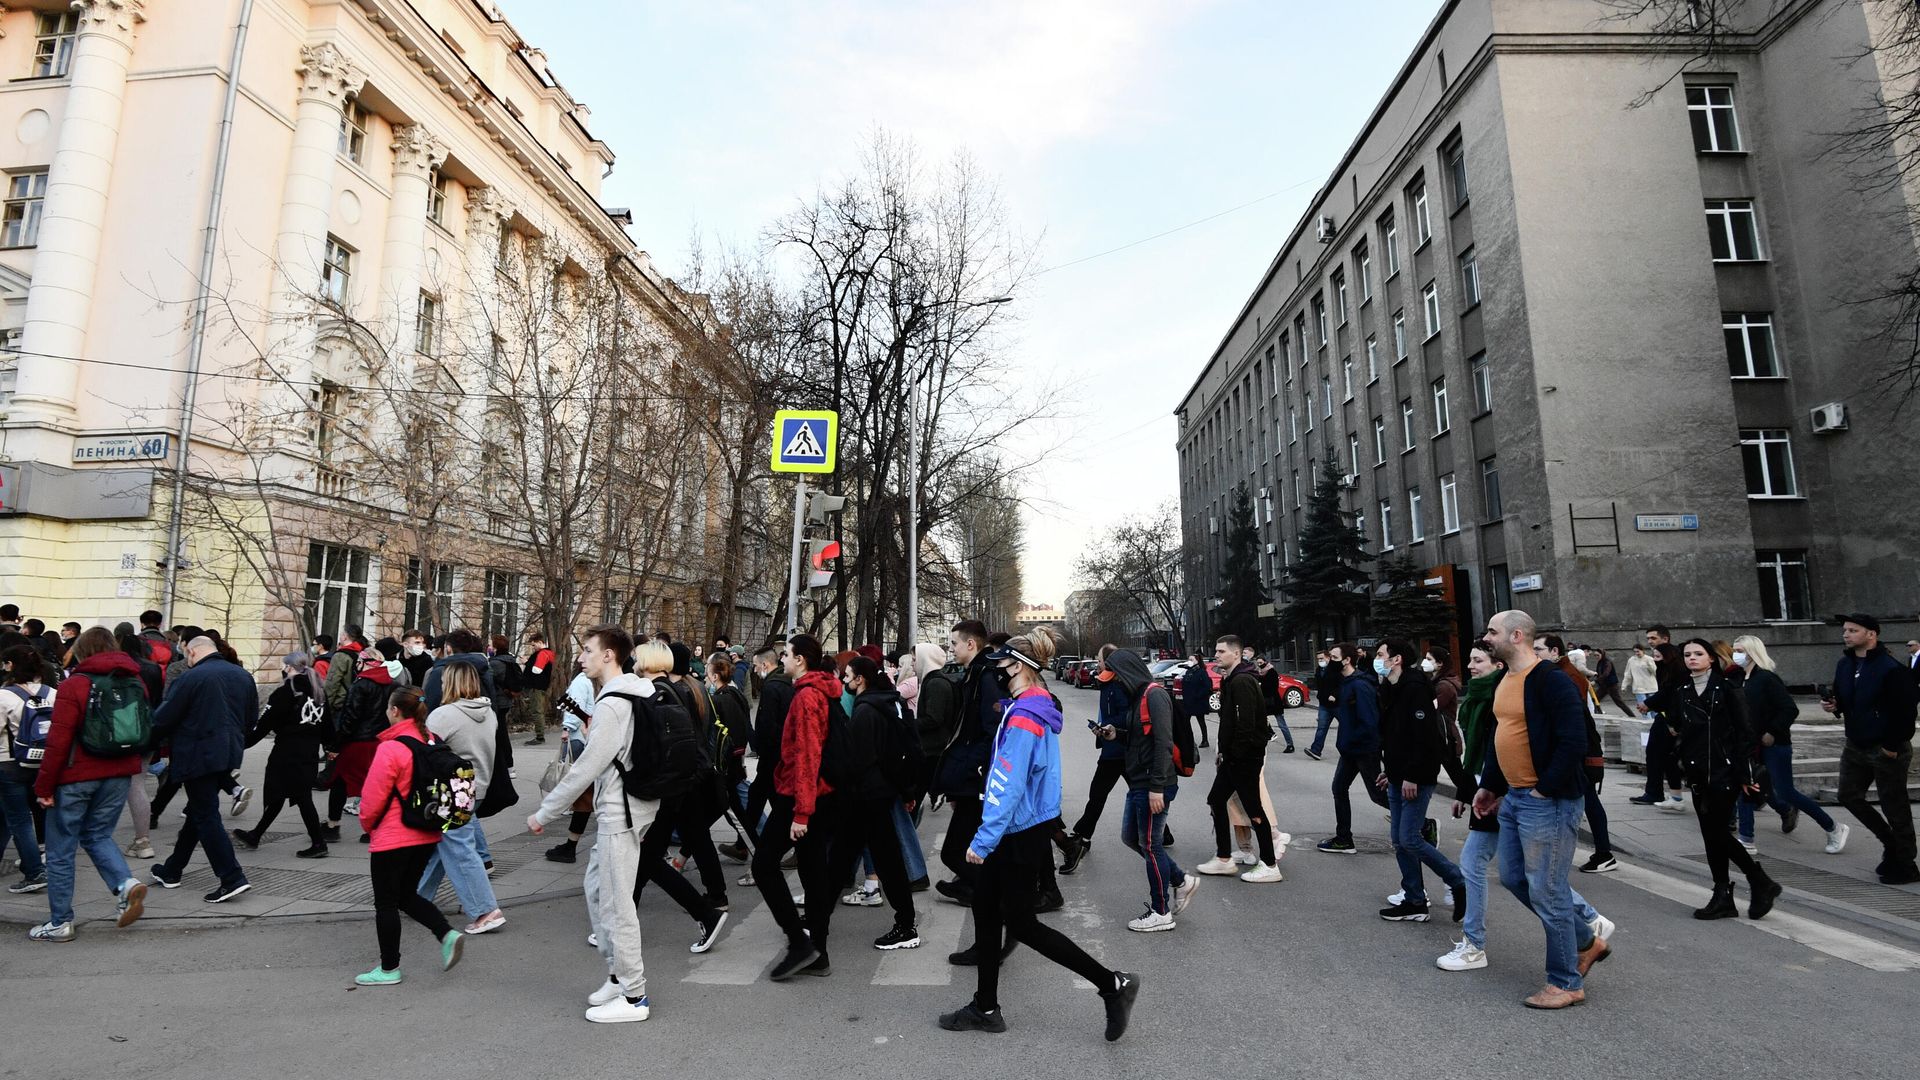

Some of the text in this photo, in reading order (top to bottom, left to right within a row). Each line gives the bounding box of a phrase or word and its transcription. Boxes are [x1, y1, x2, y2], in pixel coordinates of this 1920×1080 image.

[76, 438, 161, 457] ЛЕНИНА 60
[987, 756, 1012, 806] FILA
